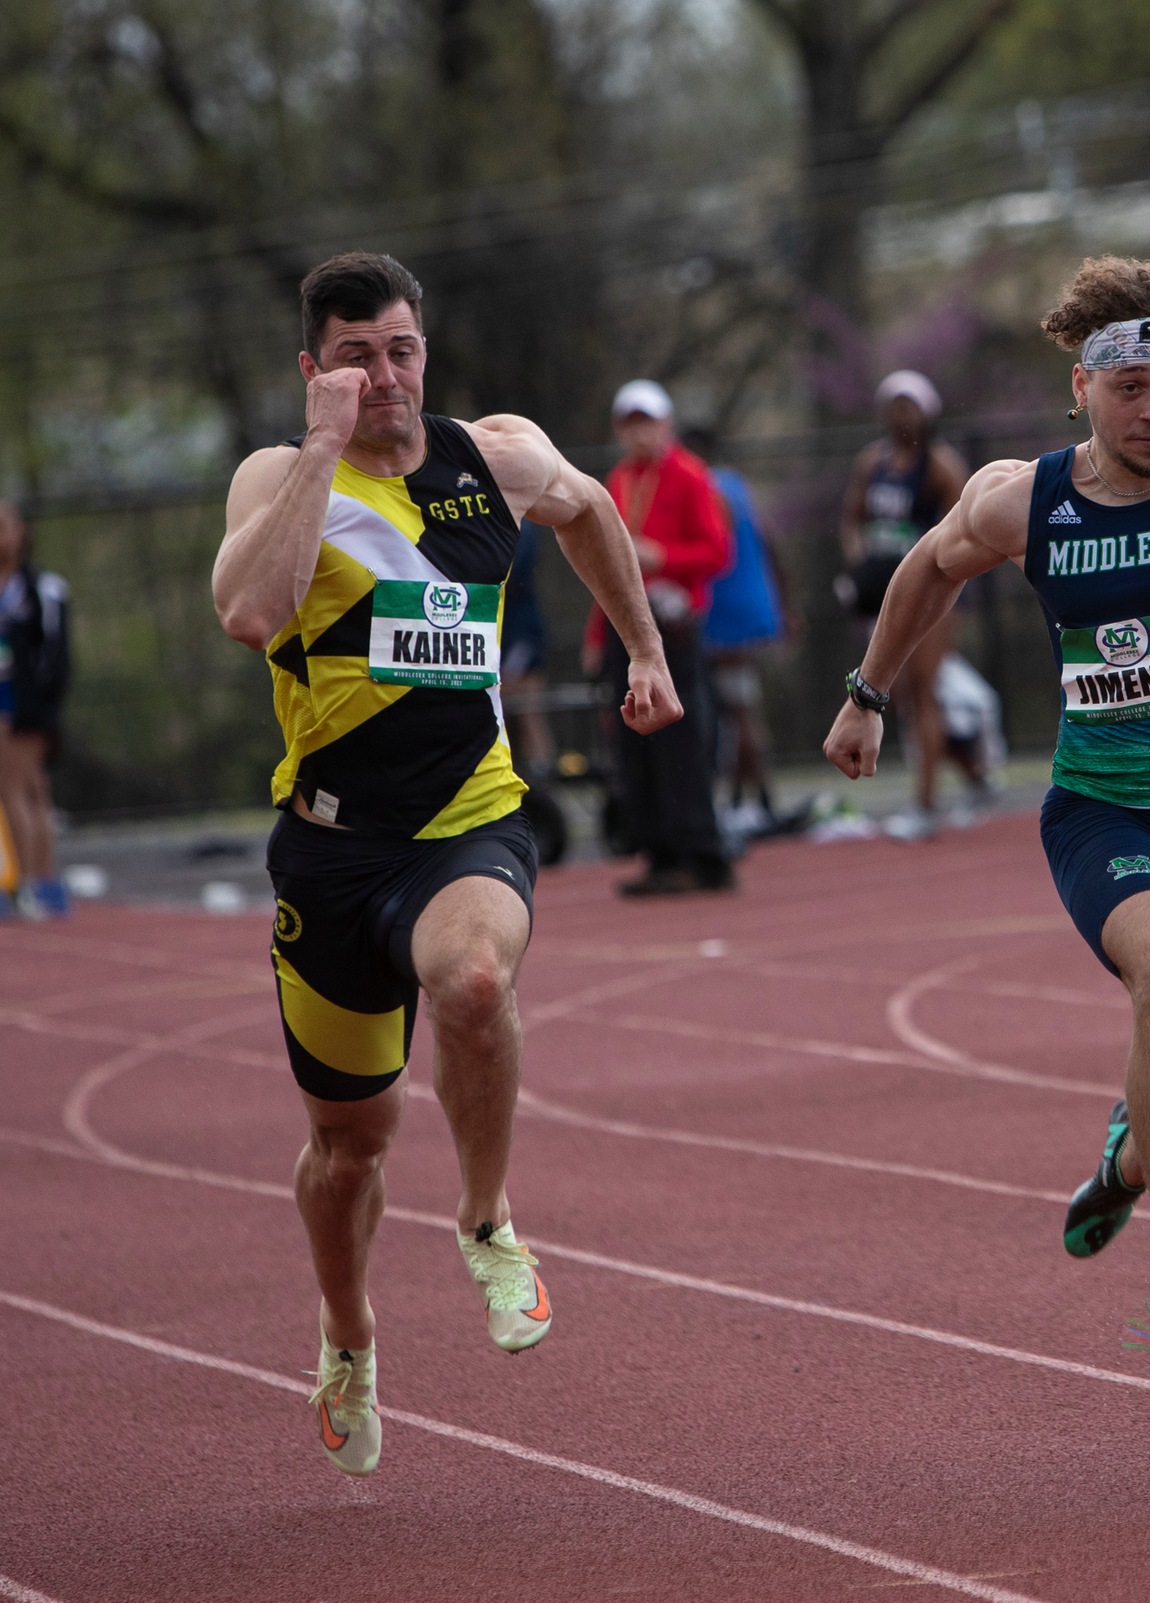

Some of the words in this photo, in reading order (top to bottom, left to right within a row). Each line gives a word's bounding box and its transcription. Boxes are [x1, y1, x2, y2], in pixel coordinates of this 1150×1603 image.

[428, 493, 490, 521] GSTC
[1048, 515, 1082, 524] adidas
[392, 630, 486, 666] KAINER
[393, 671, 426, 679] MIDDLESEX
[427, 672, 452, 680] COLLEGE
[1086, 711, 1118, 719] MIDDLESEX
[1120, 706, 1147, 716] COLLEGE
